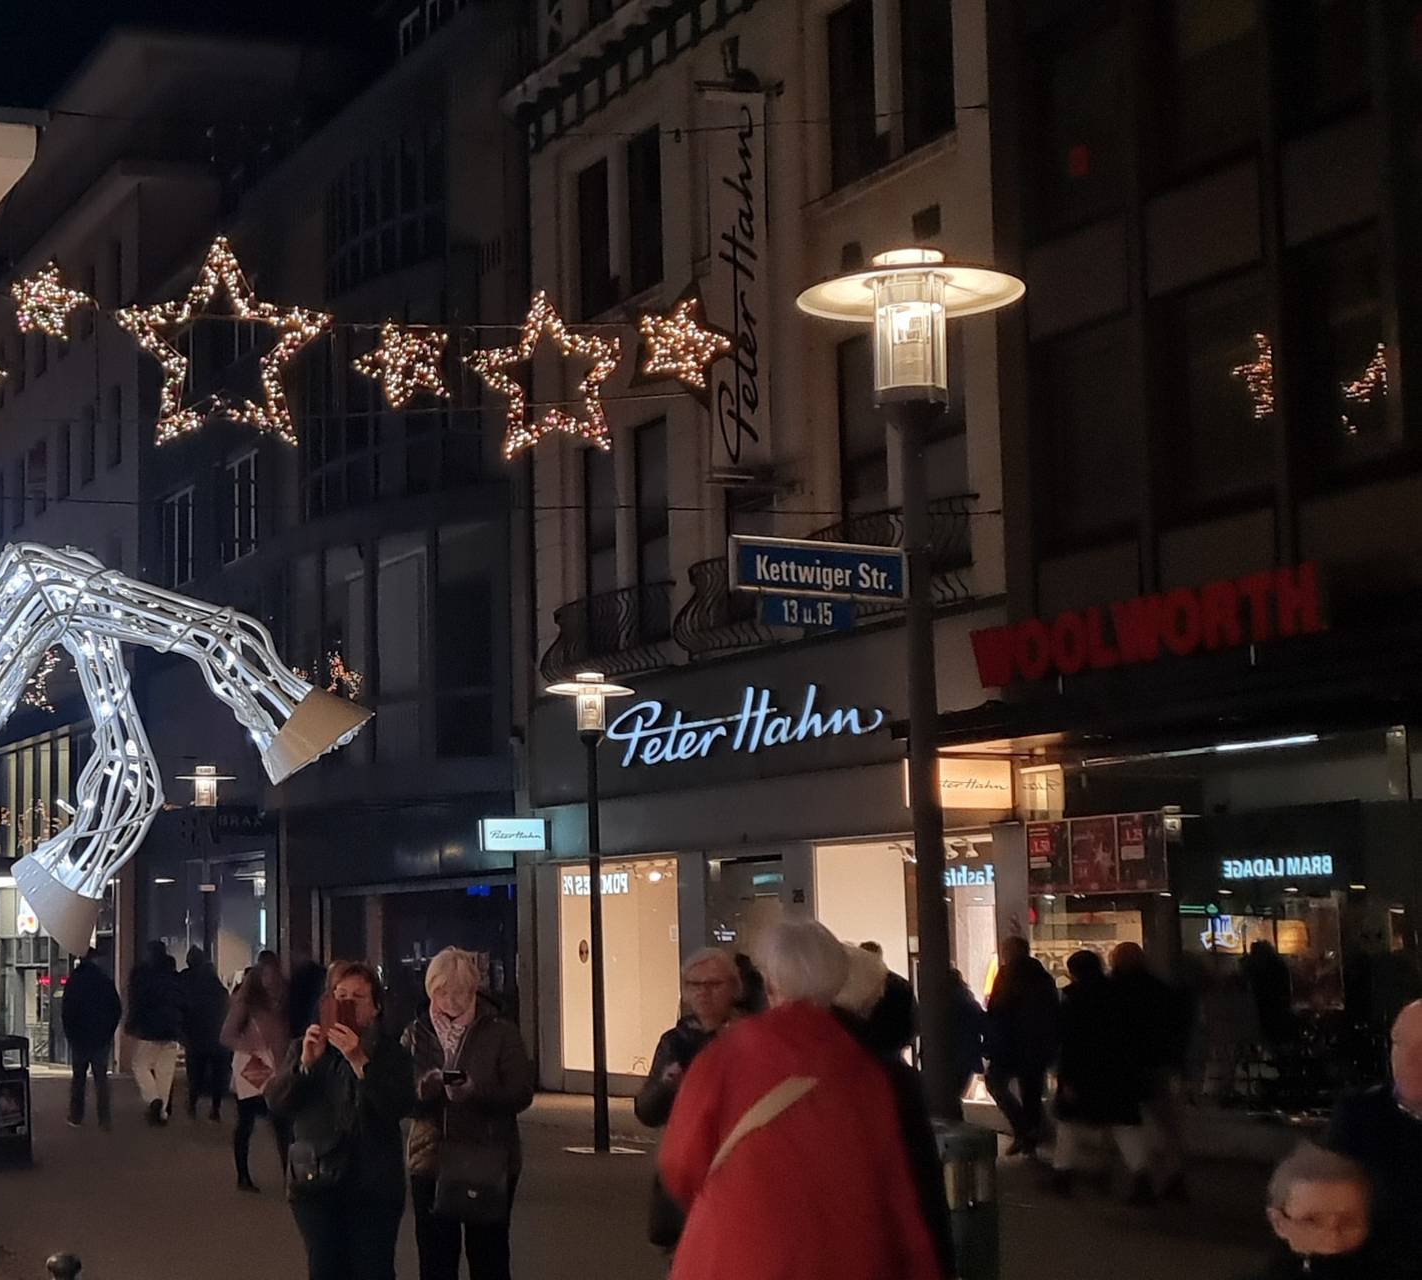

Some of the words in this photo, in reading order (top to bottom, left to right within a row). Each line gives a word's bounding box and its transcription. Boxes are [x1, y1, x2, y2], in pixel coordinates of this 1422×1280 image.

[718, 104, 760, 280] Hahn
[718, 286, 760, 465] Peter
[756, 555, 852, 591] Kettwiger
[858, 564, 894, 591] Str.
[782, 600, 799, 623] 13
[969, 563, 1322, 689] WOOLWORTH
[606, 701, 727, 768] Peter
[732, 684, 883, 753] Hahn
[942, 779, 963, 789] ter
[490, 830, 515, 839] Peter
[515, 831, 542, 839] Hahn
